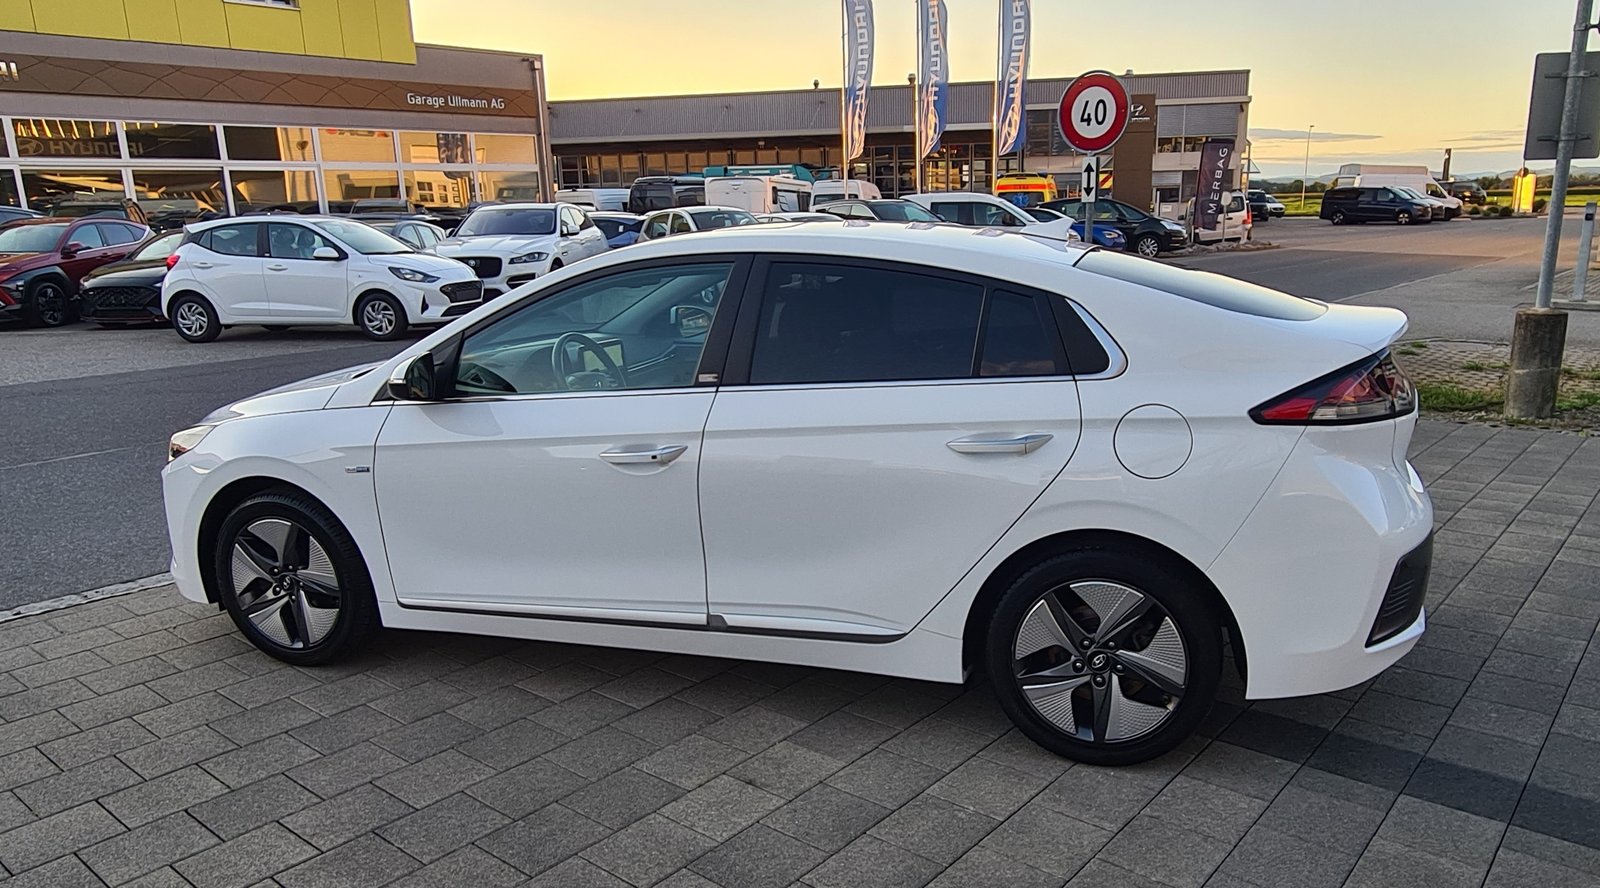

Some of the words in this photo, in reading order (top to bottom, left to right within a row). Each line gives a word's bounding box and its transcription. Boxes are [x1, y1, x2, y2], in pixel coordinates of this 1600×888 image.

[406, 92, 445, 108] Garage
[447, 94, 488, 109] Ullmann
[490, 97, 505, 109] AG
[1080, 99, 1107, 126] 40
[1207, 148, 1229, 214] MERBAG
